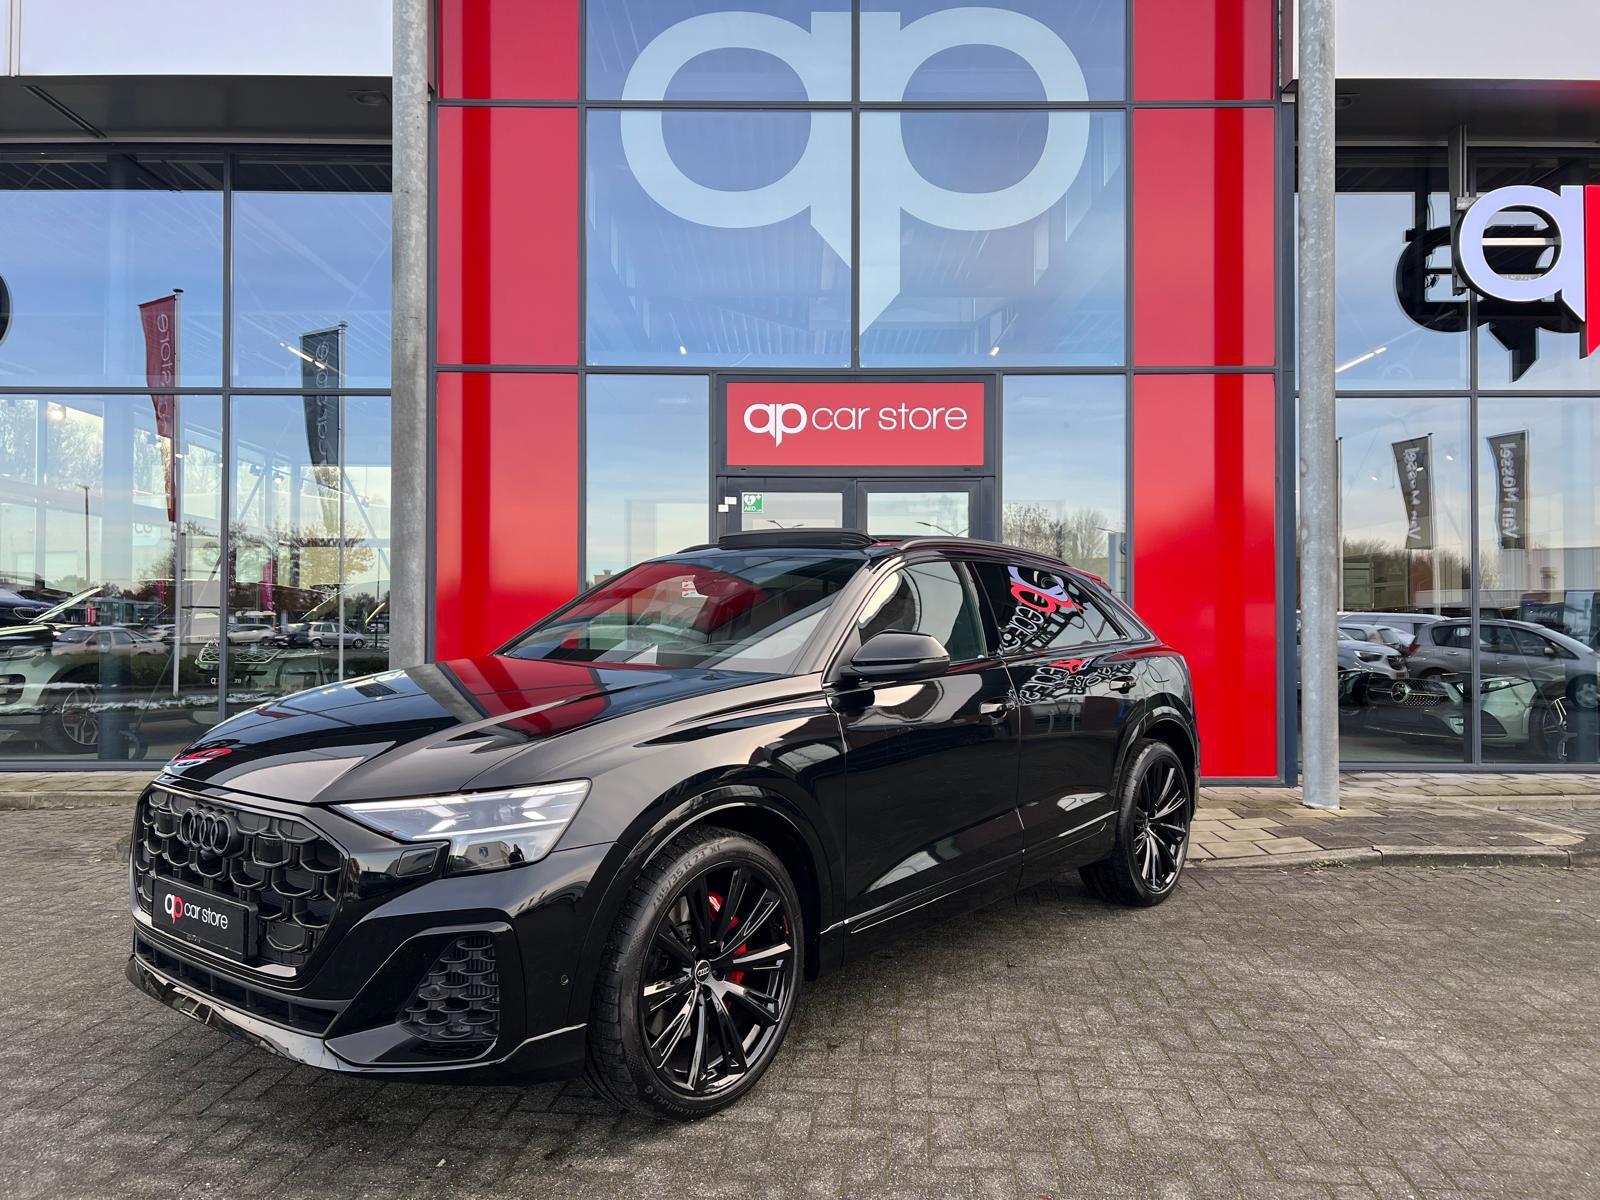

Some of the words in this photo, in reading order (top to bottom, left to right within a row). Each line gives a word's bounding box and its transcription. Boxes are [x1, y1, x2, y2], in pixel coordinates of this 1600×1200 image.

[620, 7, 1089, 336] ap
[1458, 185, 1600, 358] a
[743, 402, 808, 448] ap
[811, 407, 871, 430] car
[878, 402, 968, 431] store
[165, 893, 184, 925] ap
[184, 902, 201, 920] car
[201, 907, 229, 930] store
